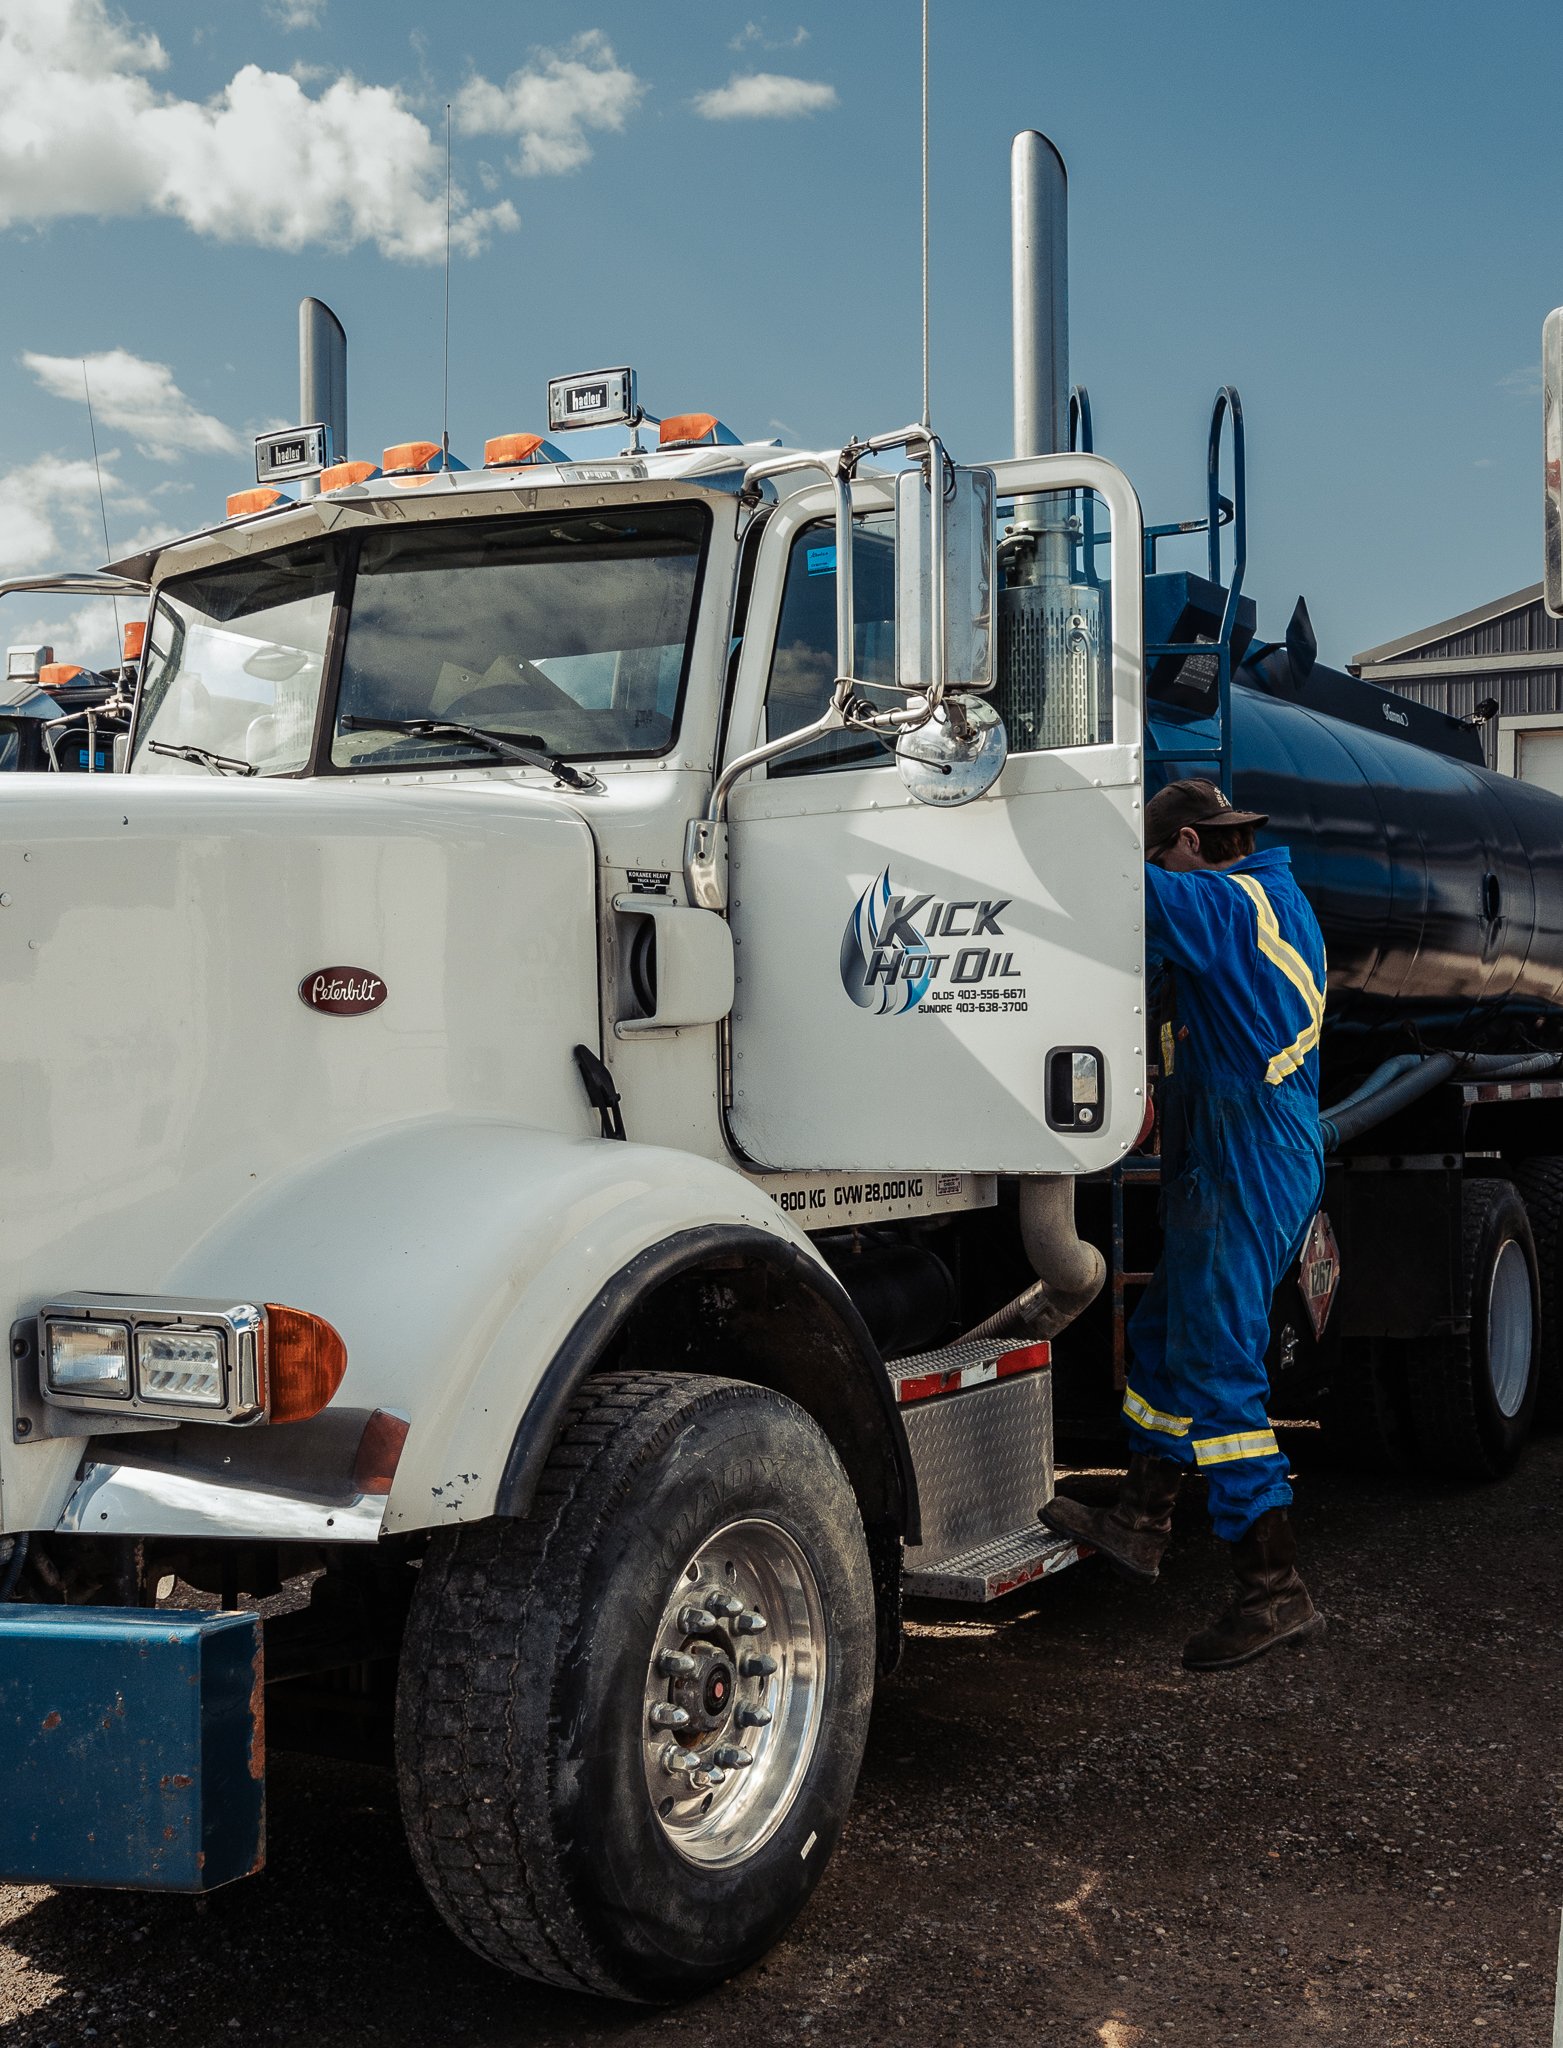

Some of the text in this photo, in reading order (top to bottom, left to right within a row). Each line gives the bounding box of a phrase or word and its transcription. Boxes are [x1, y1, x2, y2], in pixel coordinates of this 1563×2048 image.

[572, 390, 601, 411] hadley
[275, 446, 300, 465] hadley
[876, 894, 1013, 946] KICK
[864, 948, 1022, 986] HOT OIL
[312, 975, 381, 1003] Peterbilt
[932, 988, 1026, 1000] OLDS 403-556-6671
[918, 1002, 1028, 1013] SUNDRE 403-638-3700
[809, 1189, 826, 1208] KG
[834, 1186, 862, 1205] GVW
[865, 1180, 906, 1203] 28,000
[907, 1179, 923, 1197] KG
[1311, 1261, 1331, 1296] 1267
